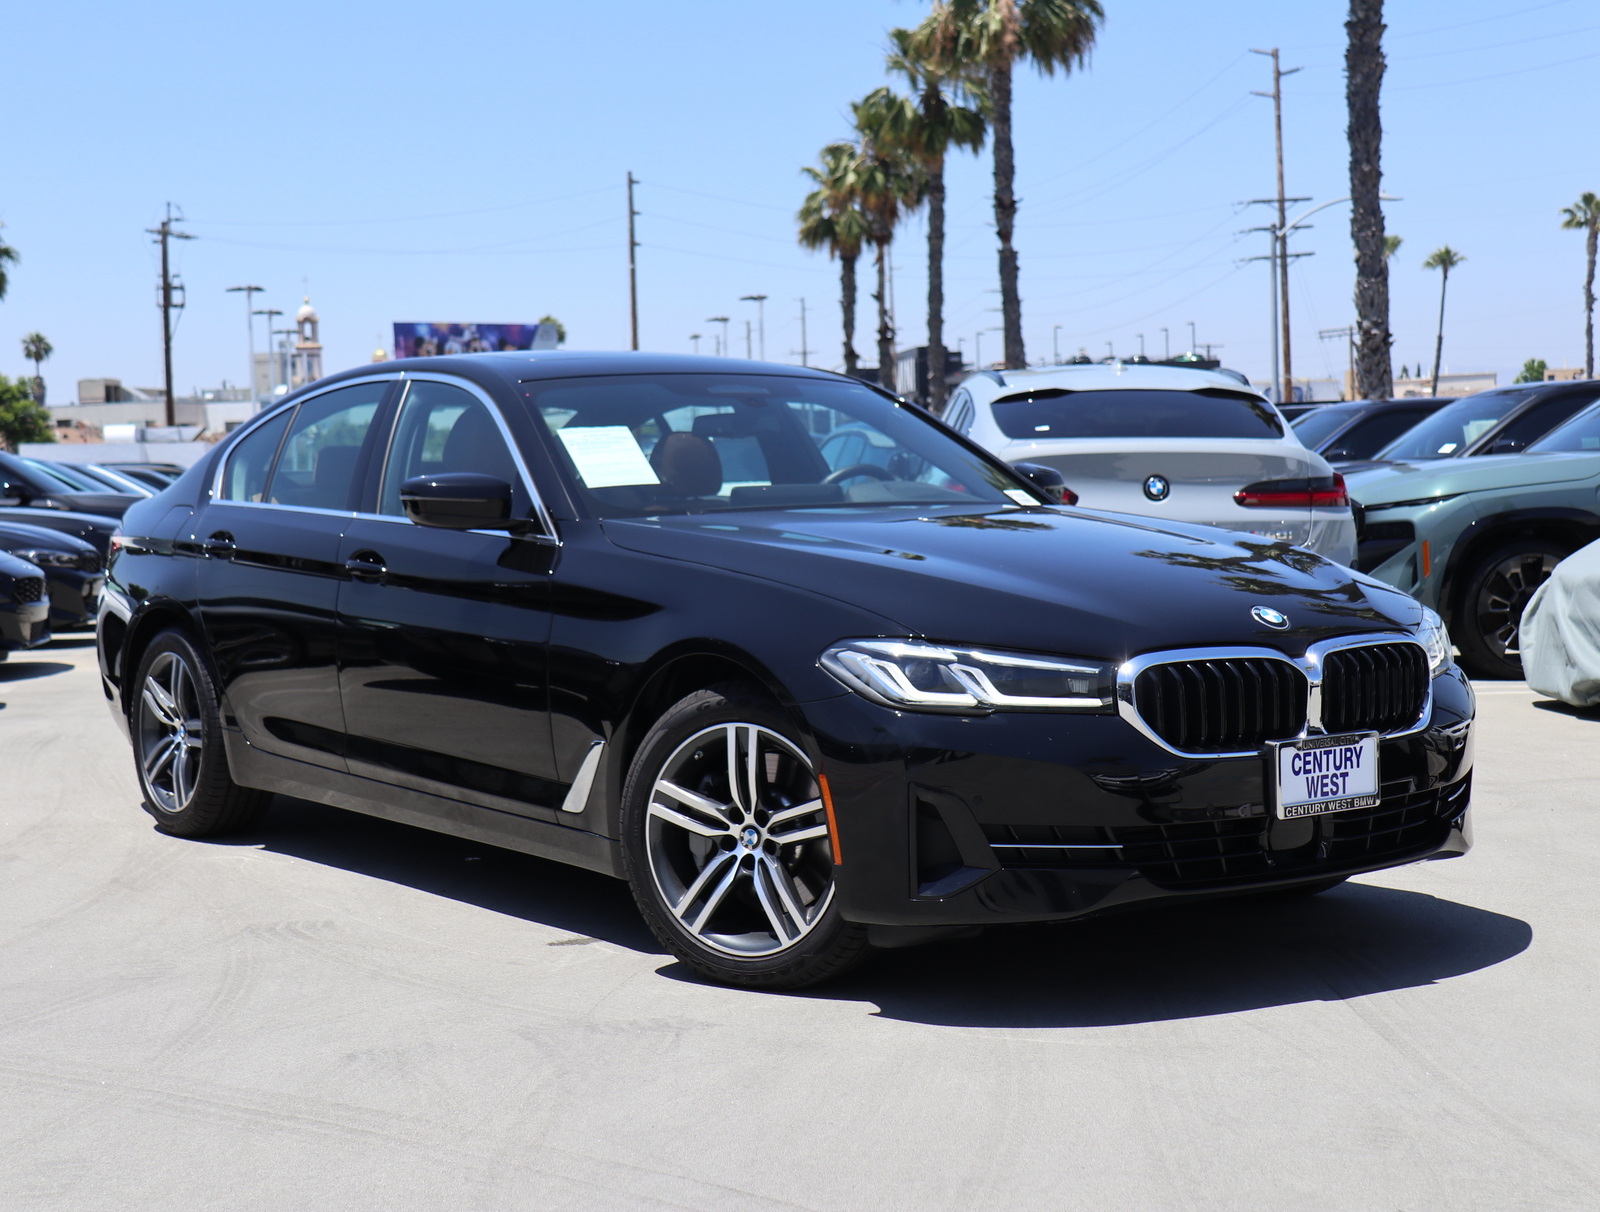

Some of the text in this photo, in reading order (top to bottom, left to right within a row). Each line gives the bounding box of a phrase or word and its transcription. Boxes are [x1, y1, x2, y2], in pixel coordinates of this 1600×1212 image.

[1303, 737, 1354, 749] UNIVERSAL CITY
[1291, 746, 1363, 776] CENTURY
[1306, 772, 1349, 798] WEST
[1286, 797, 1374, 817] CENTURY WEST BMW
